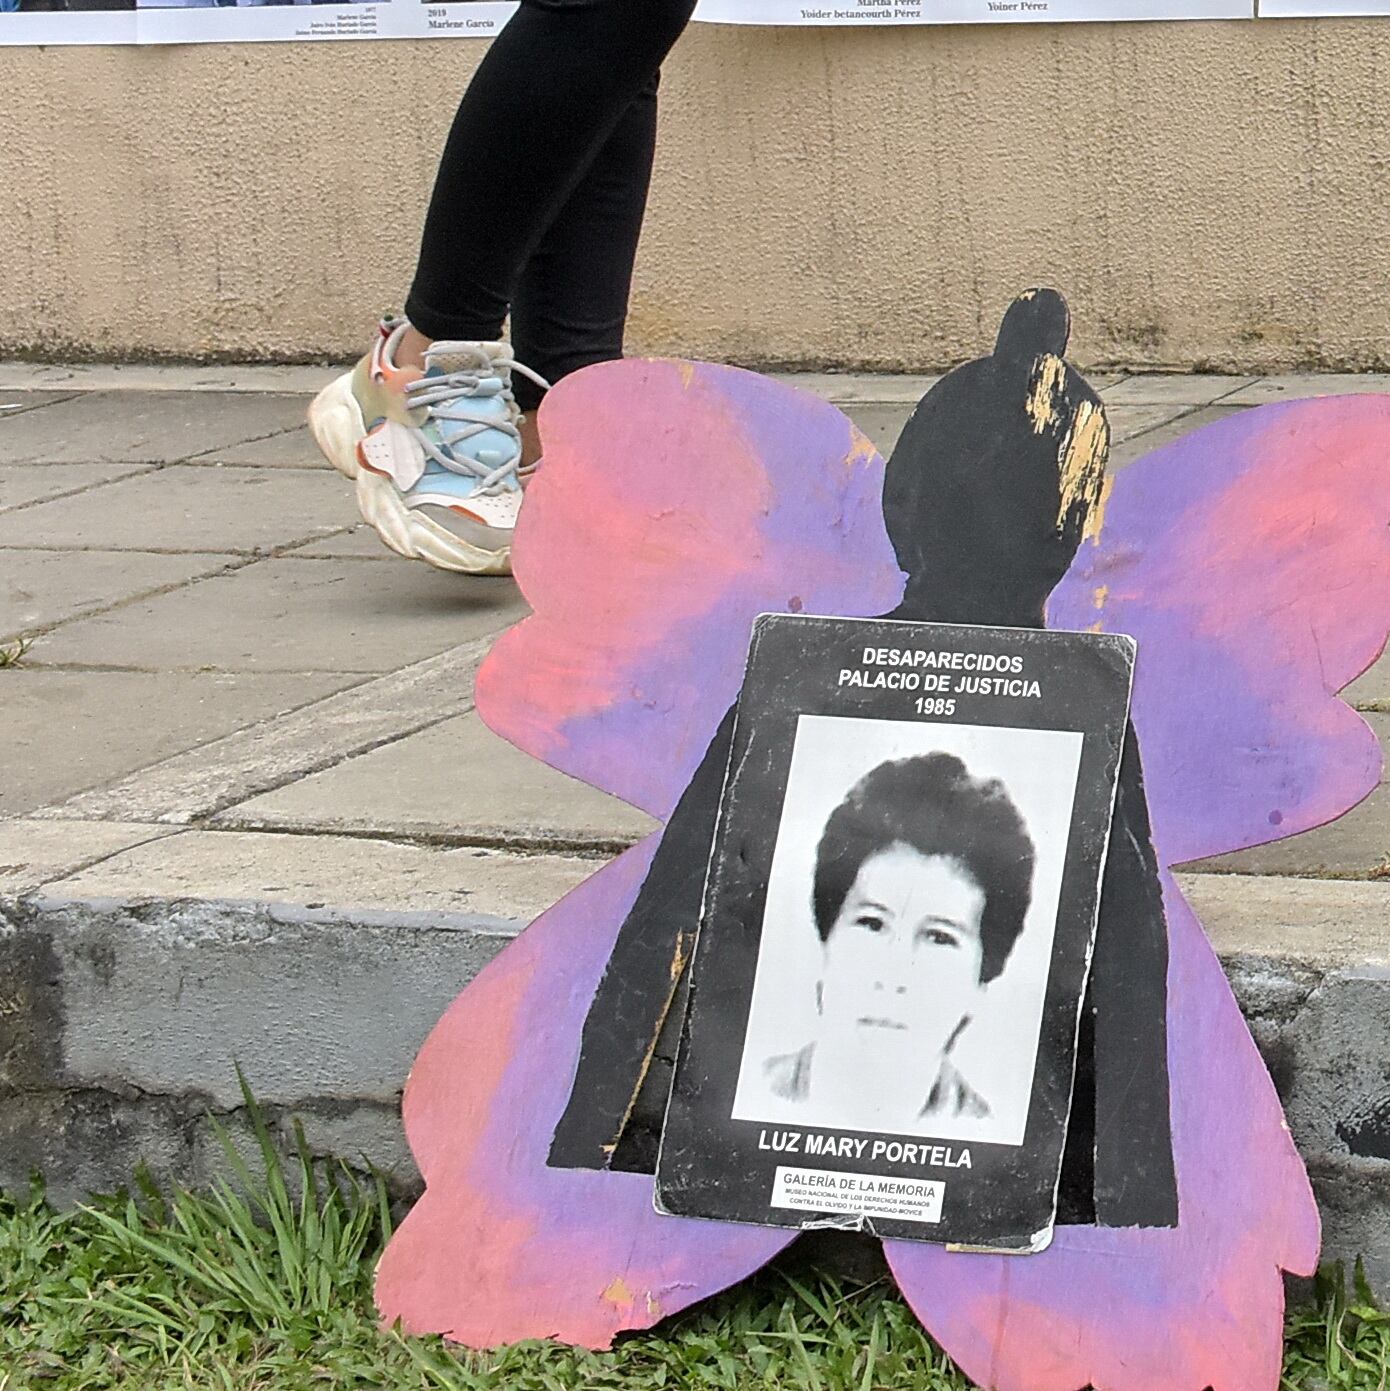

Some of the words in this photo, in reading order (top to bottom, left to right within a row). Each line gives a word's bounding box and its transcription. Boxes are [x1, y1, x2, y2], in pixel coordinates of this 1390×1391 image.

[862, 648, 1023, 673] DESAPARECIDOS
[838, 669, 920, 690] PALACIO
[924, 674, 951, 691] DE
[954, 677, 1041, 698] JUSTICIA
[915, 698, 956, 715] 1985
[758, 1131, 801, 1152] LUZ
[804, 1135, 868, 1158] MARY
[871, 1141, 971, 1169] PORTELA
[783, 1173, 836, 1188] GALERÍA
[839, 1178, 856, 1190] DE
[859, 1180, 874, 1192] LA
[877, 1182, 935, 1198] MEMORIA
